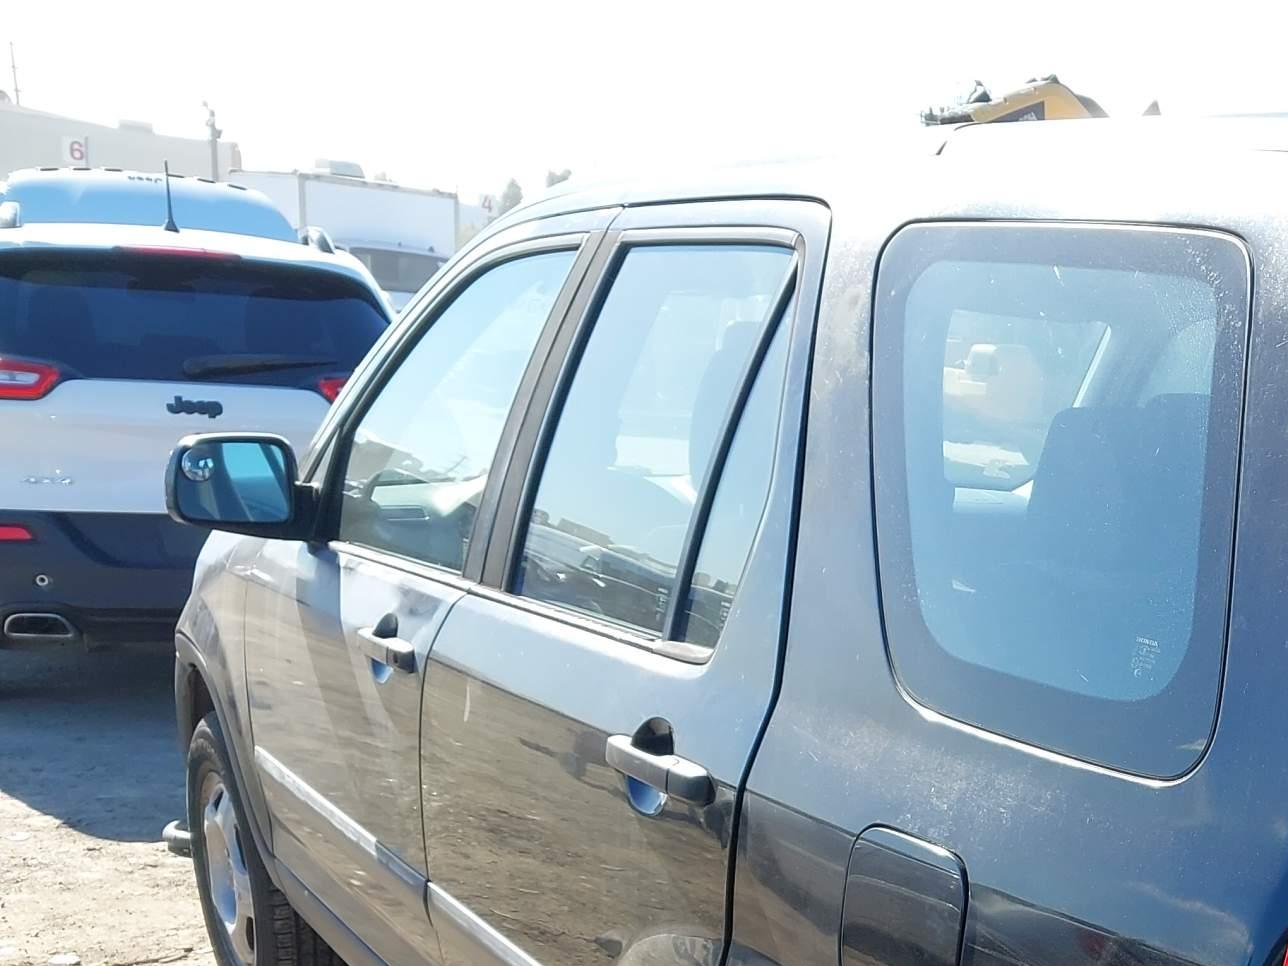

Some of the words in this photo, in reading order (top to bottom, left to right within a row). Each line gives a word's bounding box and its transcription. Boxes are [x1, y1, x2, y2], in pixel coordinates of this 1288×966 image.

[69, 140, 85, 161] 6
[481, 194, 493, 213] 4
[166, 395, 224, 419] Jeep
